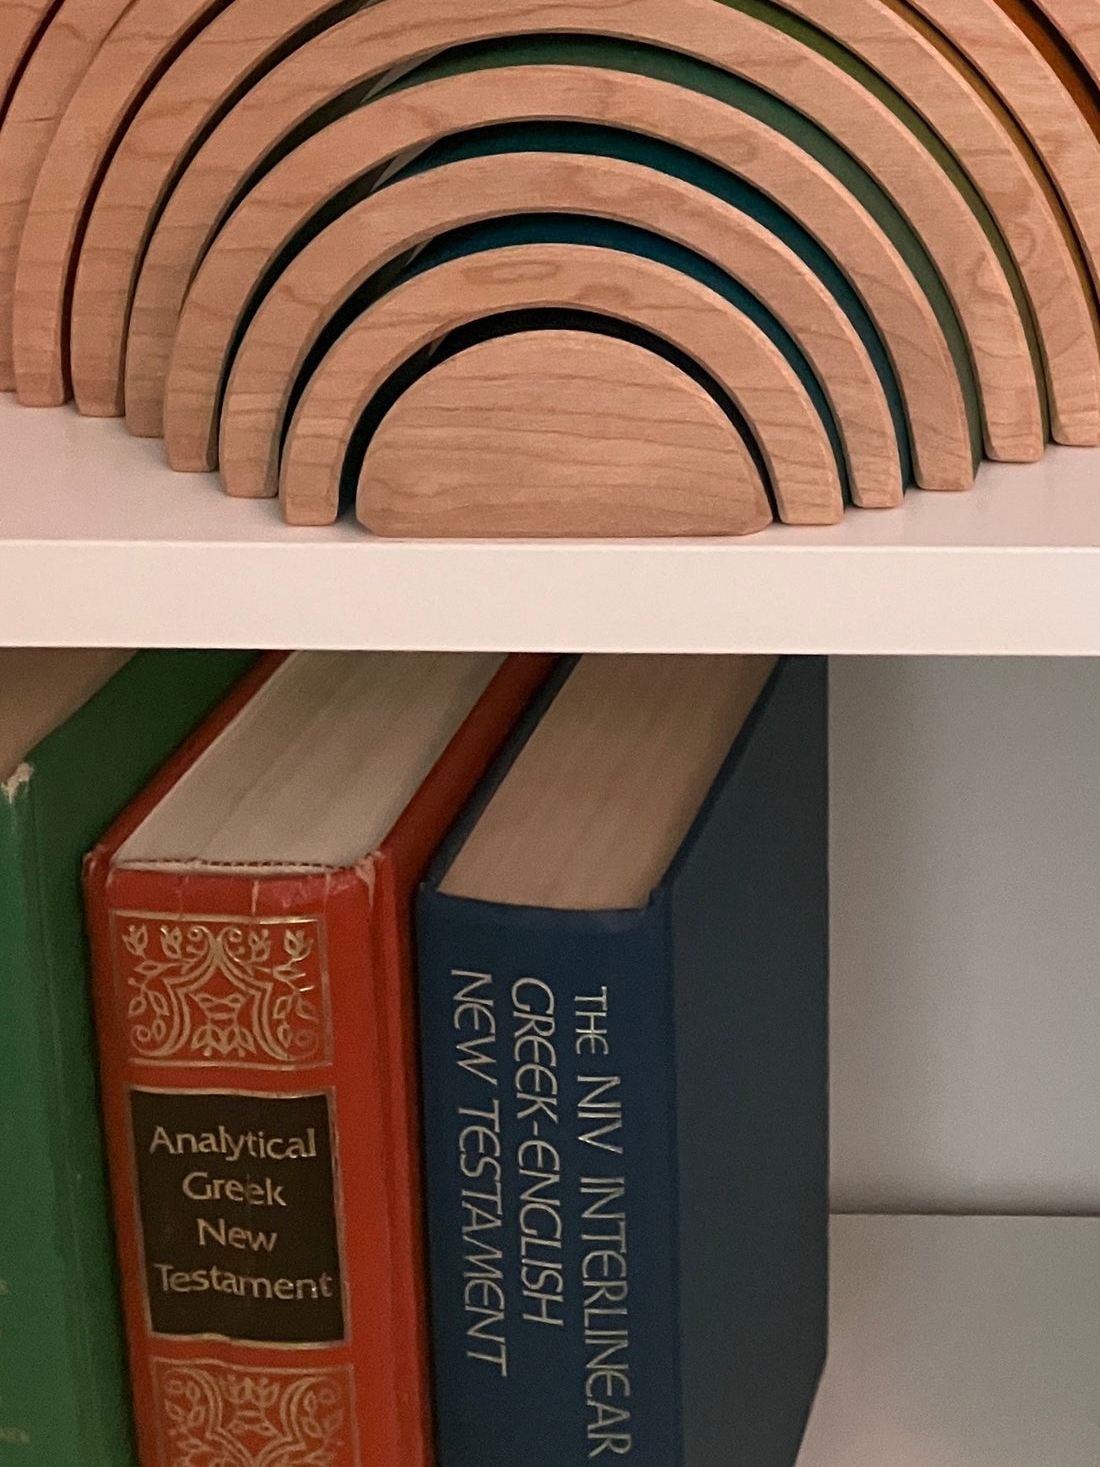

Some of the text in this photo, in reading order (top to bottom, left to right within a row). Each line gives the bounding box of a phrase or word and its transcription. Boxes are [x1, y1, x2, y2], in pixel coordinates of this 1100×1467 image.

[149, 1125, 317, 1161] Analytical
[510, 975, 566, 1326] GREEK-ENGLISH
[181, 1171, 288, 1207] Greek
[450, 967, 509, 1377] NEW TESTAMENT
[196, 1218, 278, 1253] New
[574, 985, 634, 1459] THE NIV INTERLINEAR
[153, 1263, 334, 1300] Testament
